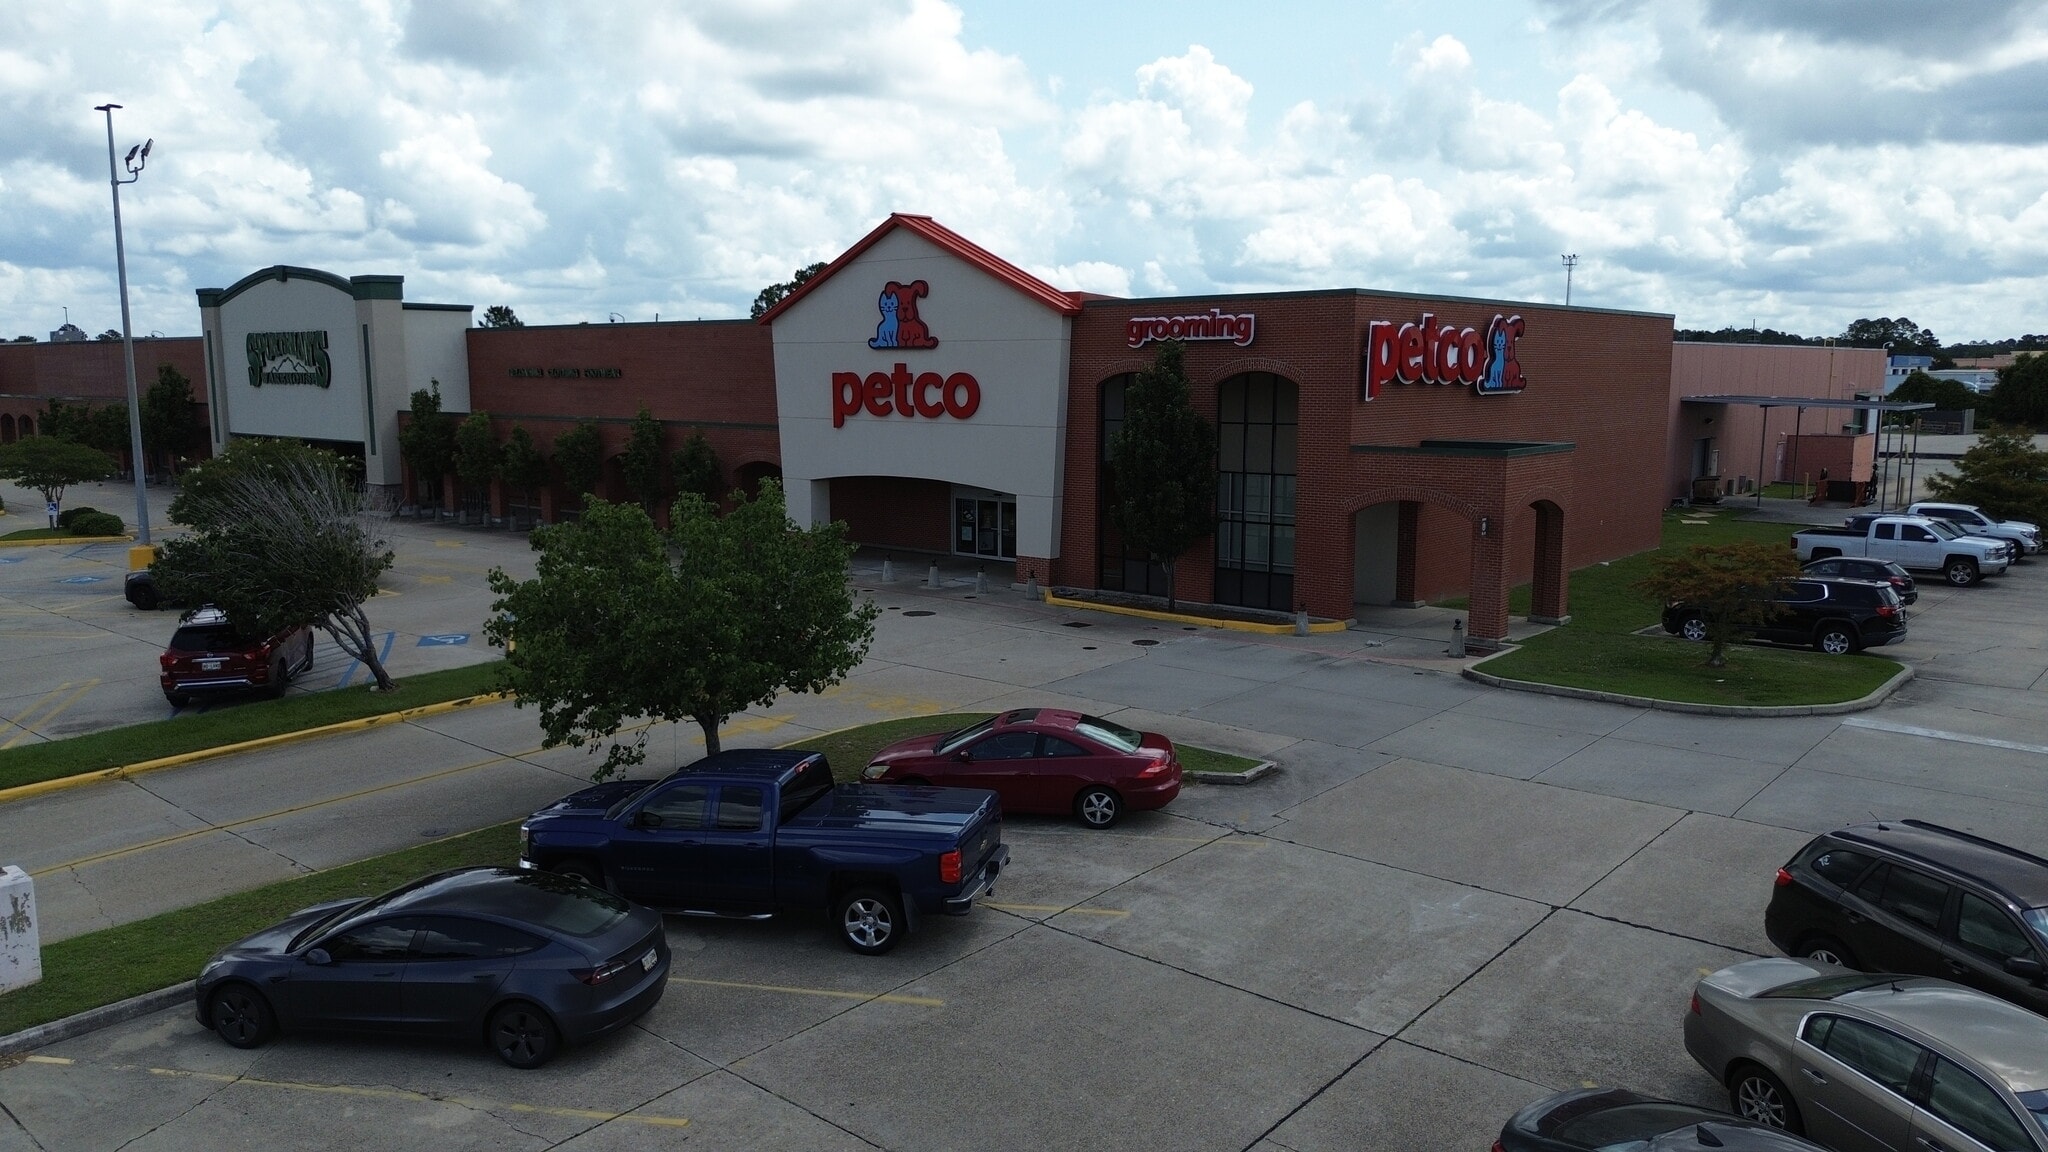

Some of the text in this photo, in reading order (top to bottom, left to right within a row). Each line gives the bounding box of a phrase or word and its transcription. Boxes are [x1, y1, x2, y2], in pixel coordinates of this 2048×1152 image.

[1126, 309, 1254, 348] grooming
[1366, 313, 1486, 401] petco
[832, 363, 981, 428] petco
